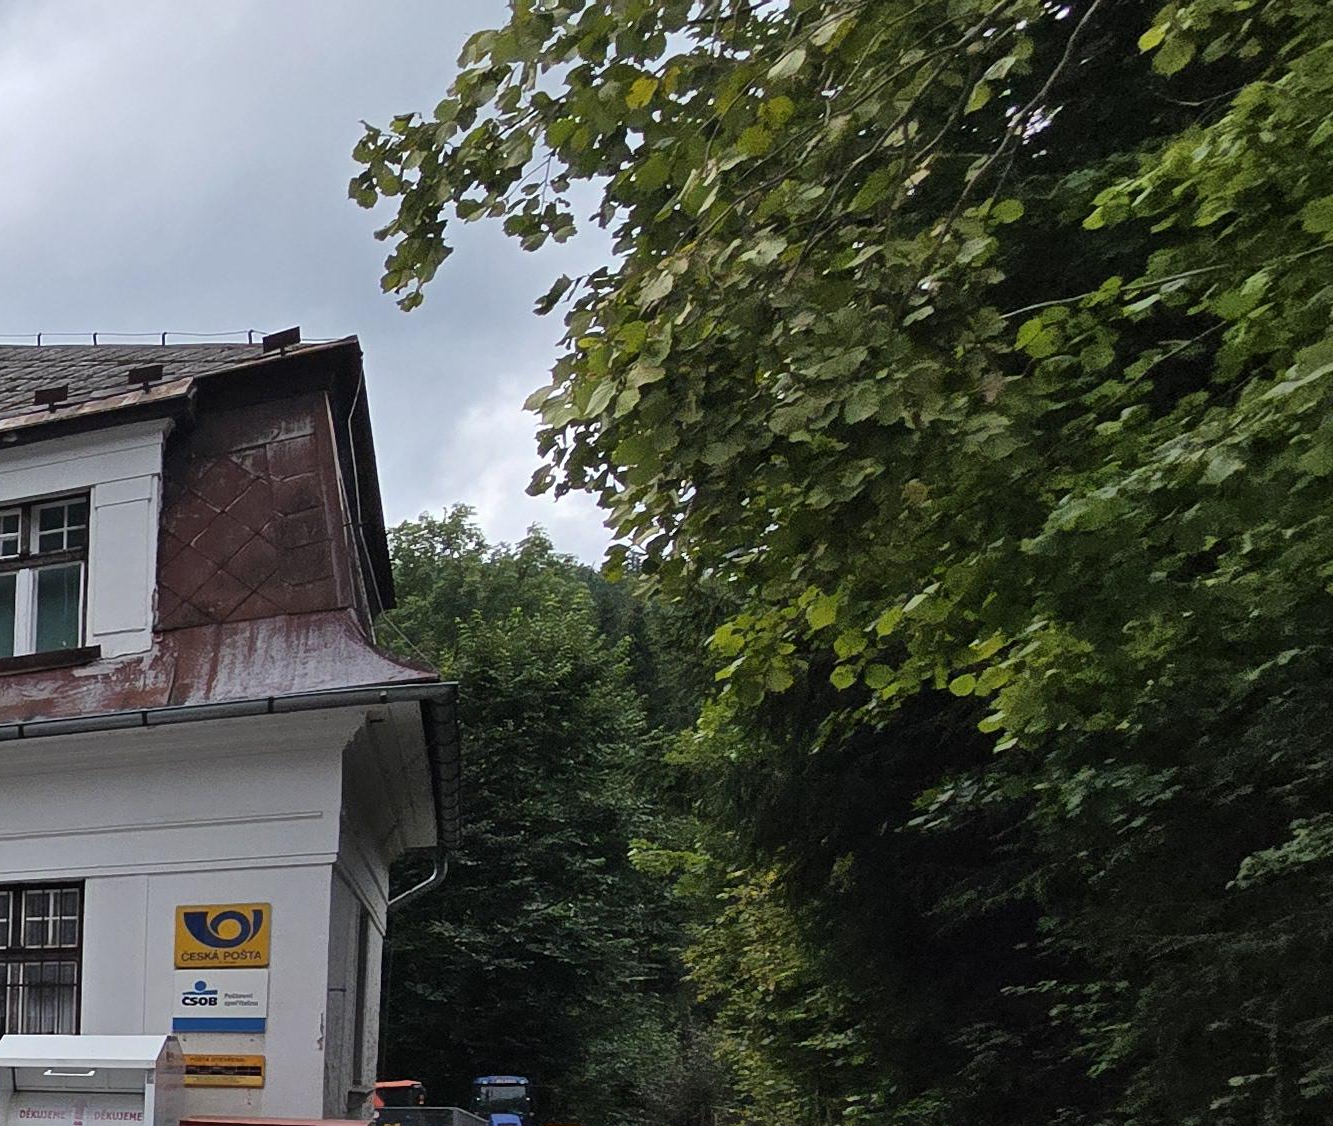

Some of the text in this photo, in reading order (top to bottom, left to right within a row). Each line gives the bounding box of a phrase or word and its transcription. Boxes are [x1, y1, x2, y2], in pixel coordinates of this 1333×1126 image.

[181, 949, 262, 961] ČESKÁ POŠTA
[19, 1107, 143, 1121] DĚKUJEME DĚKUJEME
